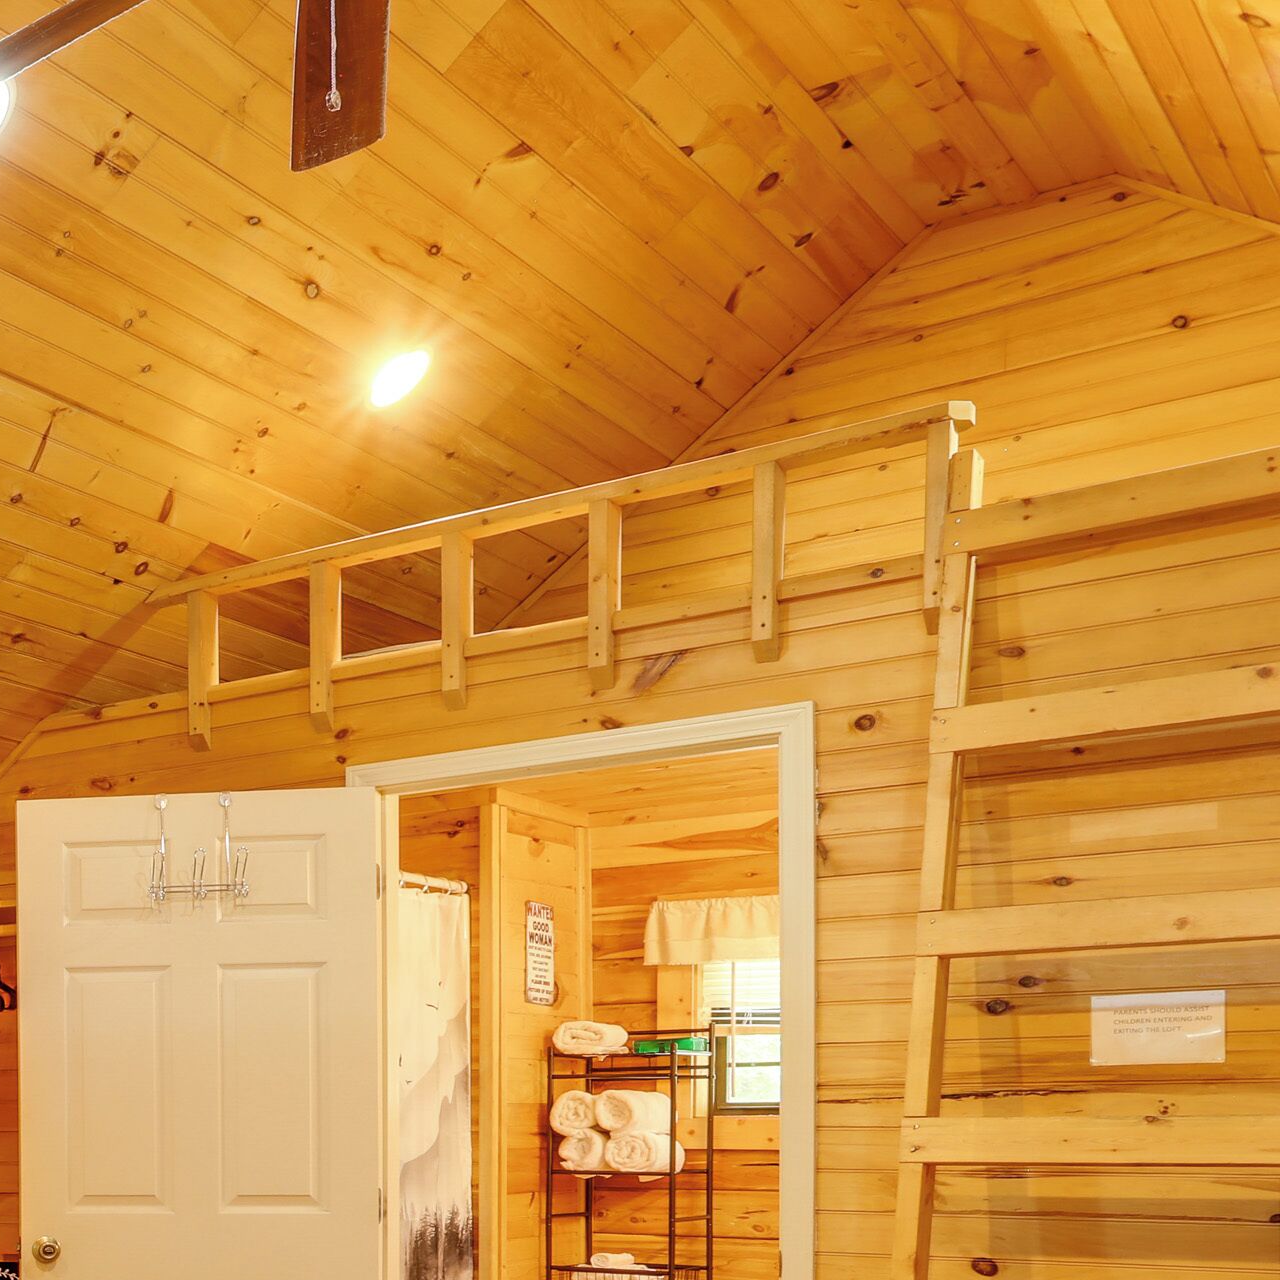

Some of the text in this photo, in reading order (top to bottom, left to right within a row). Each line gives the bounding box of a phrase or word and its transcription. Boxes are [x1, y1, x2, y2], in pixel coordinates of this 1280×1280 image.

[527, 902, 554, 921] WANTED
[532, 920, 549, 933] GOOD
[528, 931, 553, 947] WOMAN
[1113, 1004, 1210, 1015] PARENTS SHOULD ASSIST
[1153, 1016, 1193, 1024] ENTERING
[1113, 1027, 1144, 1035] EXITING
